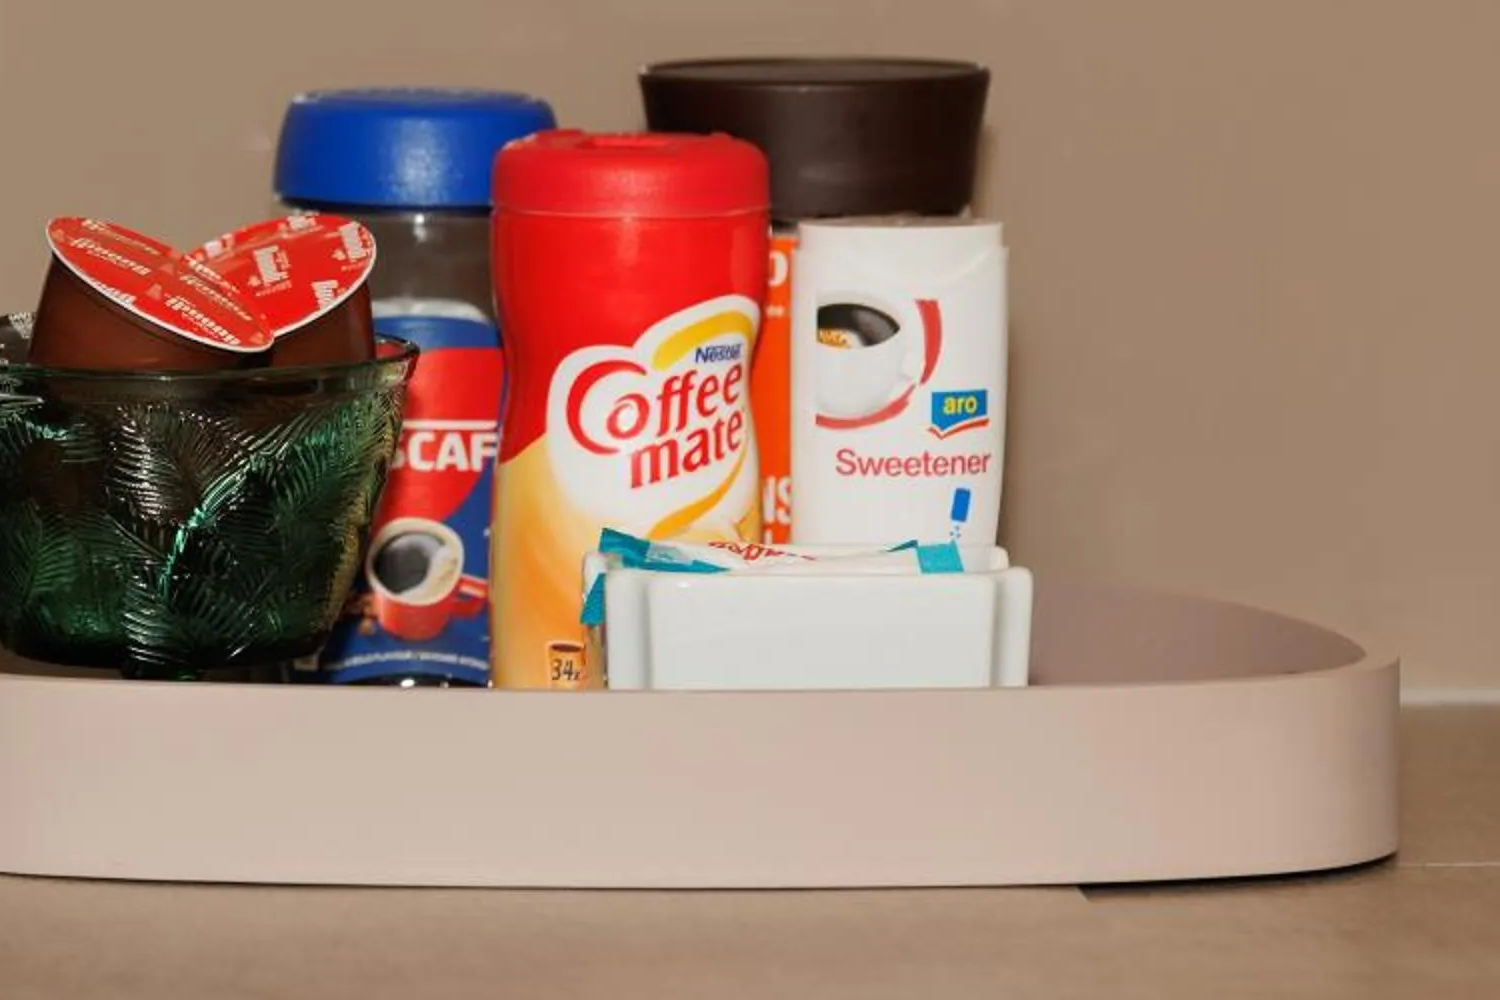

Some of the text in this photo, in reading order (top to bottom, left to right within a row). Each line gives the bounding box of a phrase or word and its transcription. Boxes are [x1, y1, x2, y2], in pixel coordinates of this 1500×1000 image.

[566, 363, 743, 456] Coffee
[943, 396, 978, 416] aro
[630, 410, 743, 489] mate
[835, 447, 992, 478] Sweetener
